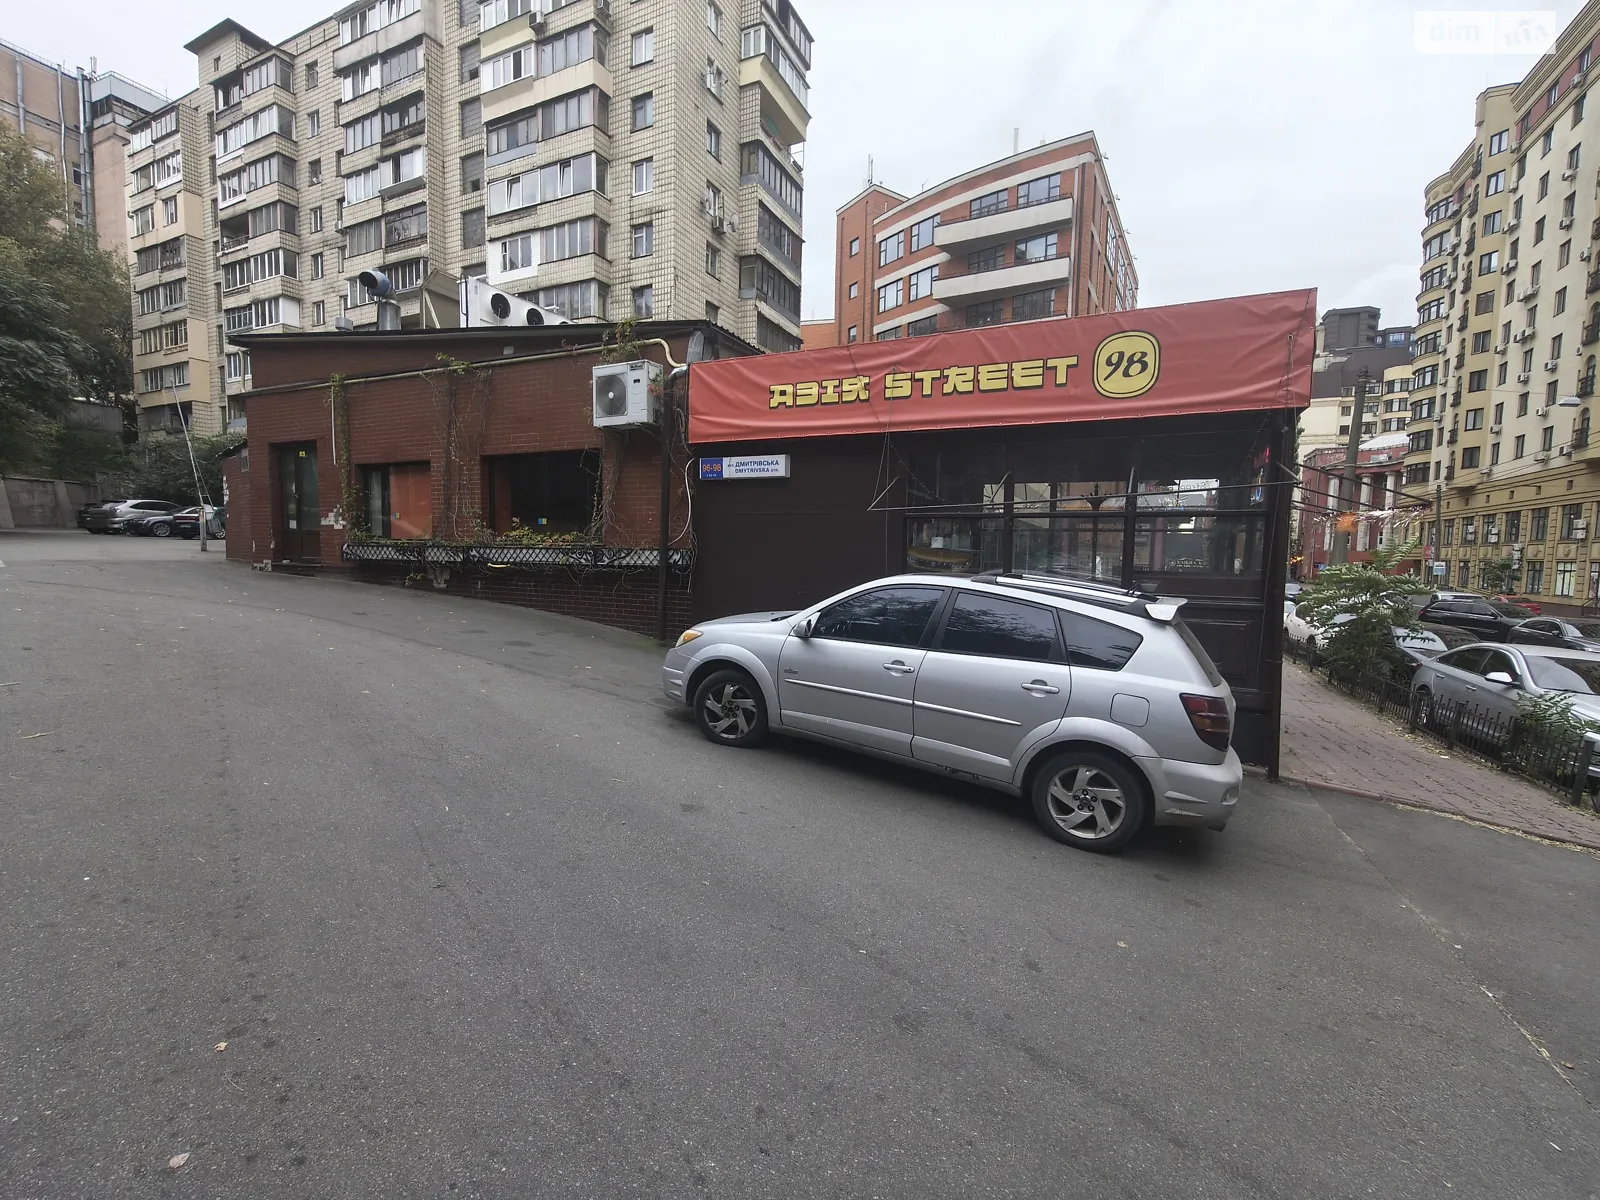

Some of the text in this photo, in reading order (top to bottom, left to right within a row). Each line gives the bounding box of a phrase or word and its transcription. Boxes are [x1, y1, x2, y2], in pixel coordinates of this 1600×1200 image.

[884, 355, 1079, 400] STREET
[1104, 351, 1149, 382] 98
[735, 460, 779, 468] ДМИТРІВСЬКА
